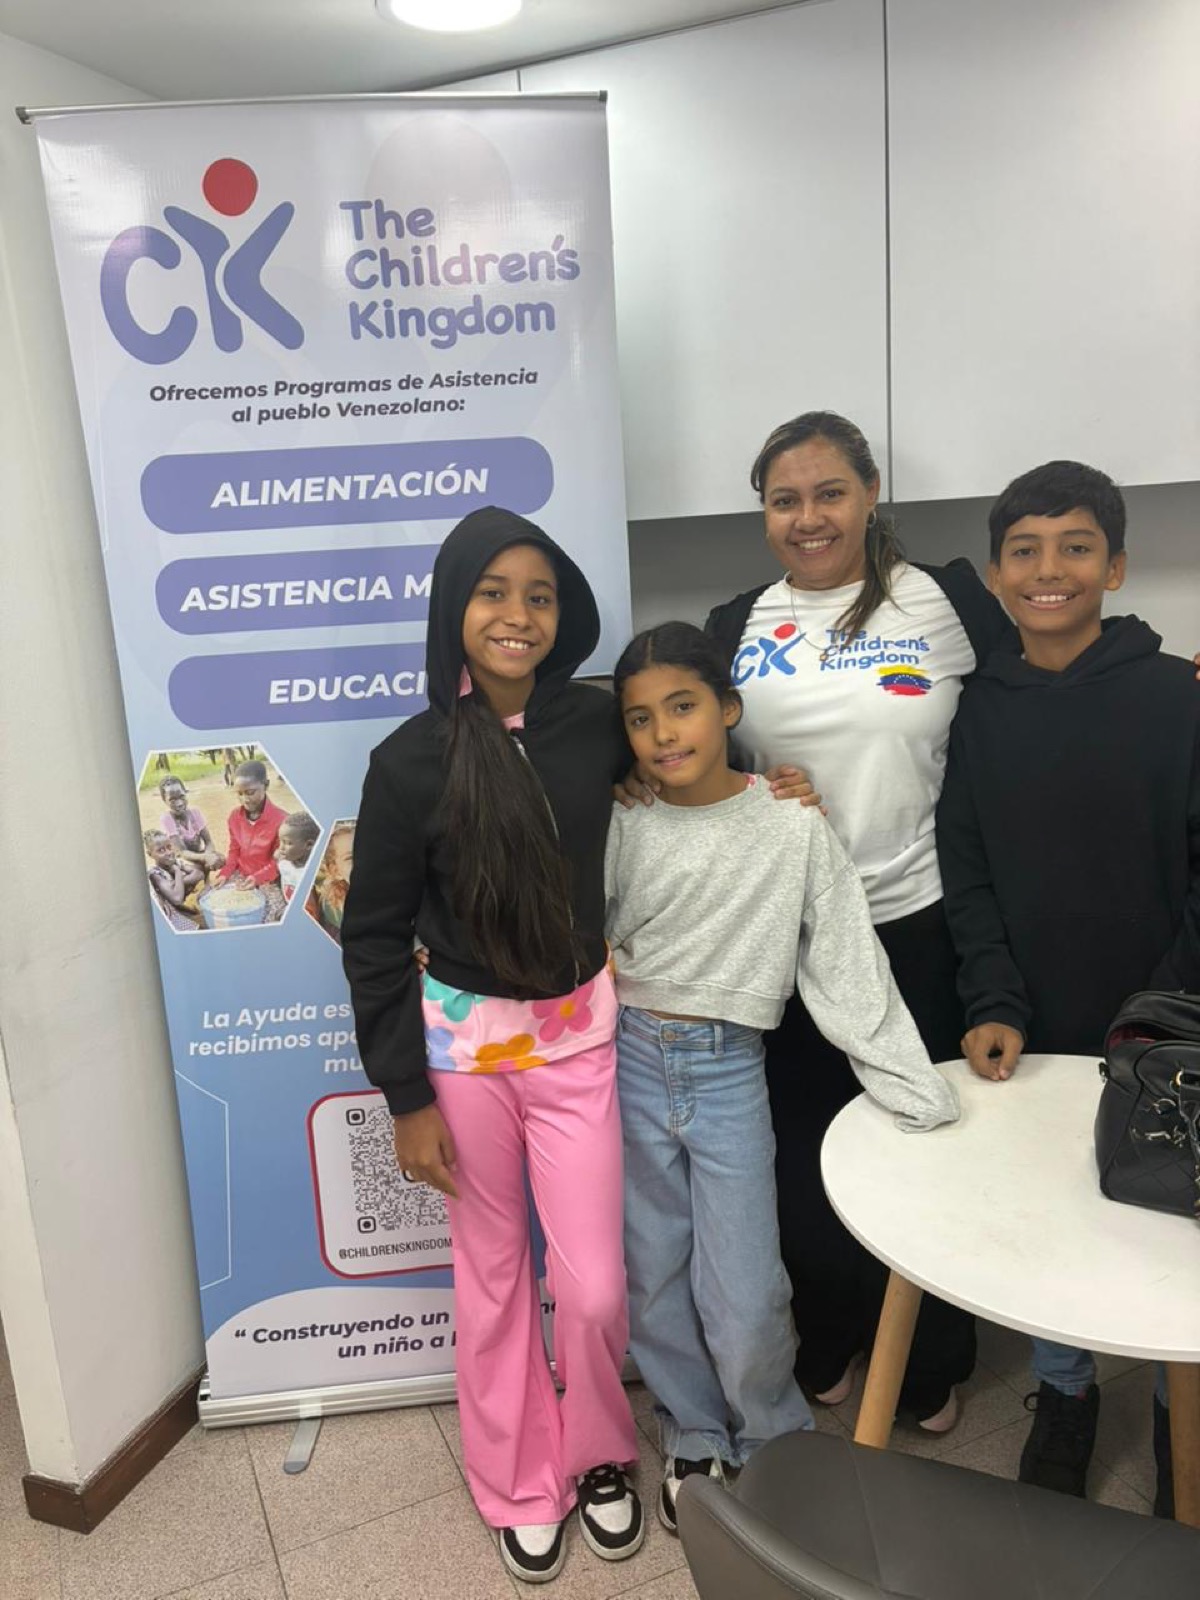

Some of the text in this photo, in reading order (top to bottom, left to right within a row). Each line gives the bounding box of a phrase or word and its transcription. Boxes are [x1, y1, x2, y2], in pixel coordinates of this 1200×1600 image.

[339, 199, 436, 240] The
[345, 235, 581, 290] Children's
[349, 295, 557, 350] Kingdom
[149, 368, 538, 402] Ofrecemos Programas de Asistencia
[231, 396, 466, 425] al pueblo Venezolano:
[210, 463, 489, 508] ALIMENTACIÓN
[180, 576, 393, 612] ASISTENCIA
[819, 651, 920, 671] Kingdom
[269, 670, 427, 704] EDUCACI
[203, 1010, 230, 1029] La
[236, 1003, 317, 1031] Ayuda
[189, 1033, 311, 1056] recibimos
[253, 1313, 415, 1343] Construyendo
[421, 1311, 450, 1326] un
[338, 1343, 366, 1359] un
[373, 1336, 424, 1356] niño
[430, 1335, 445, 1348] a
